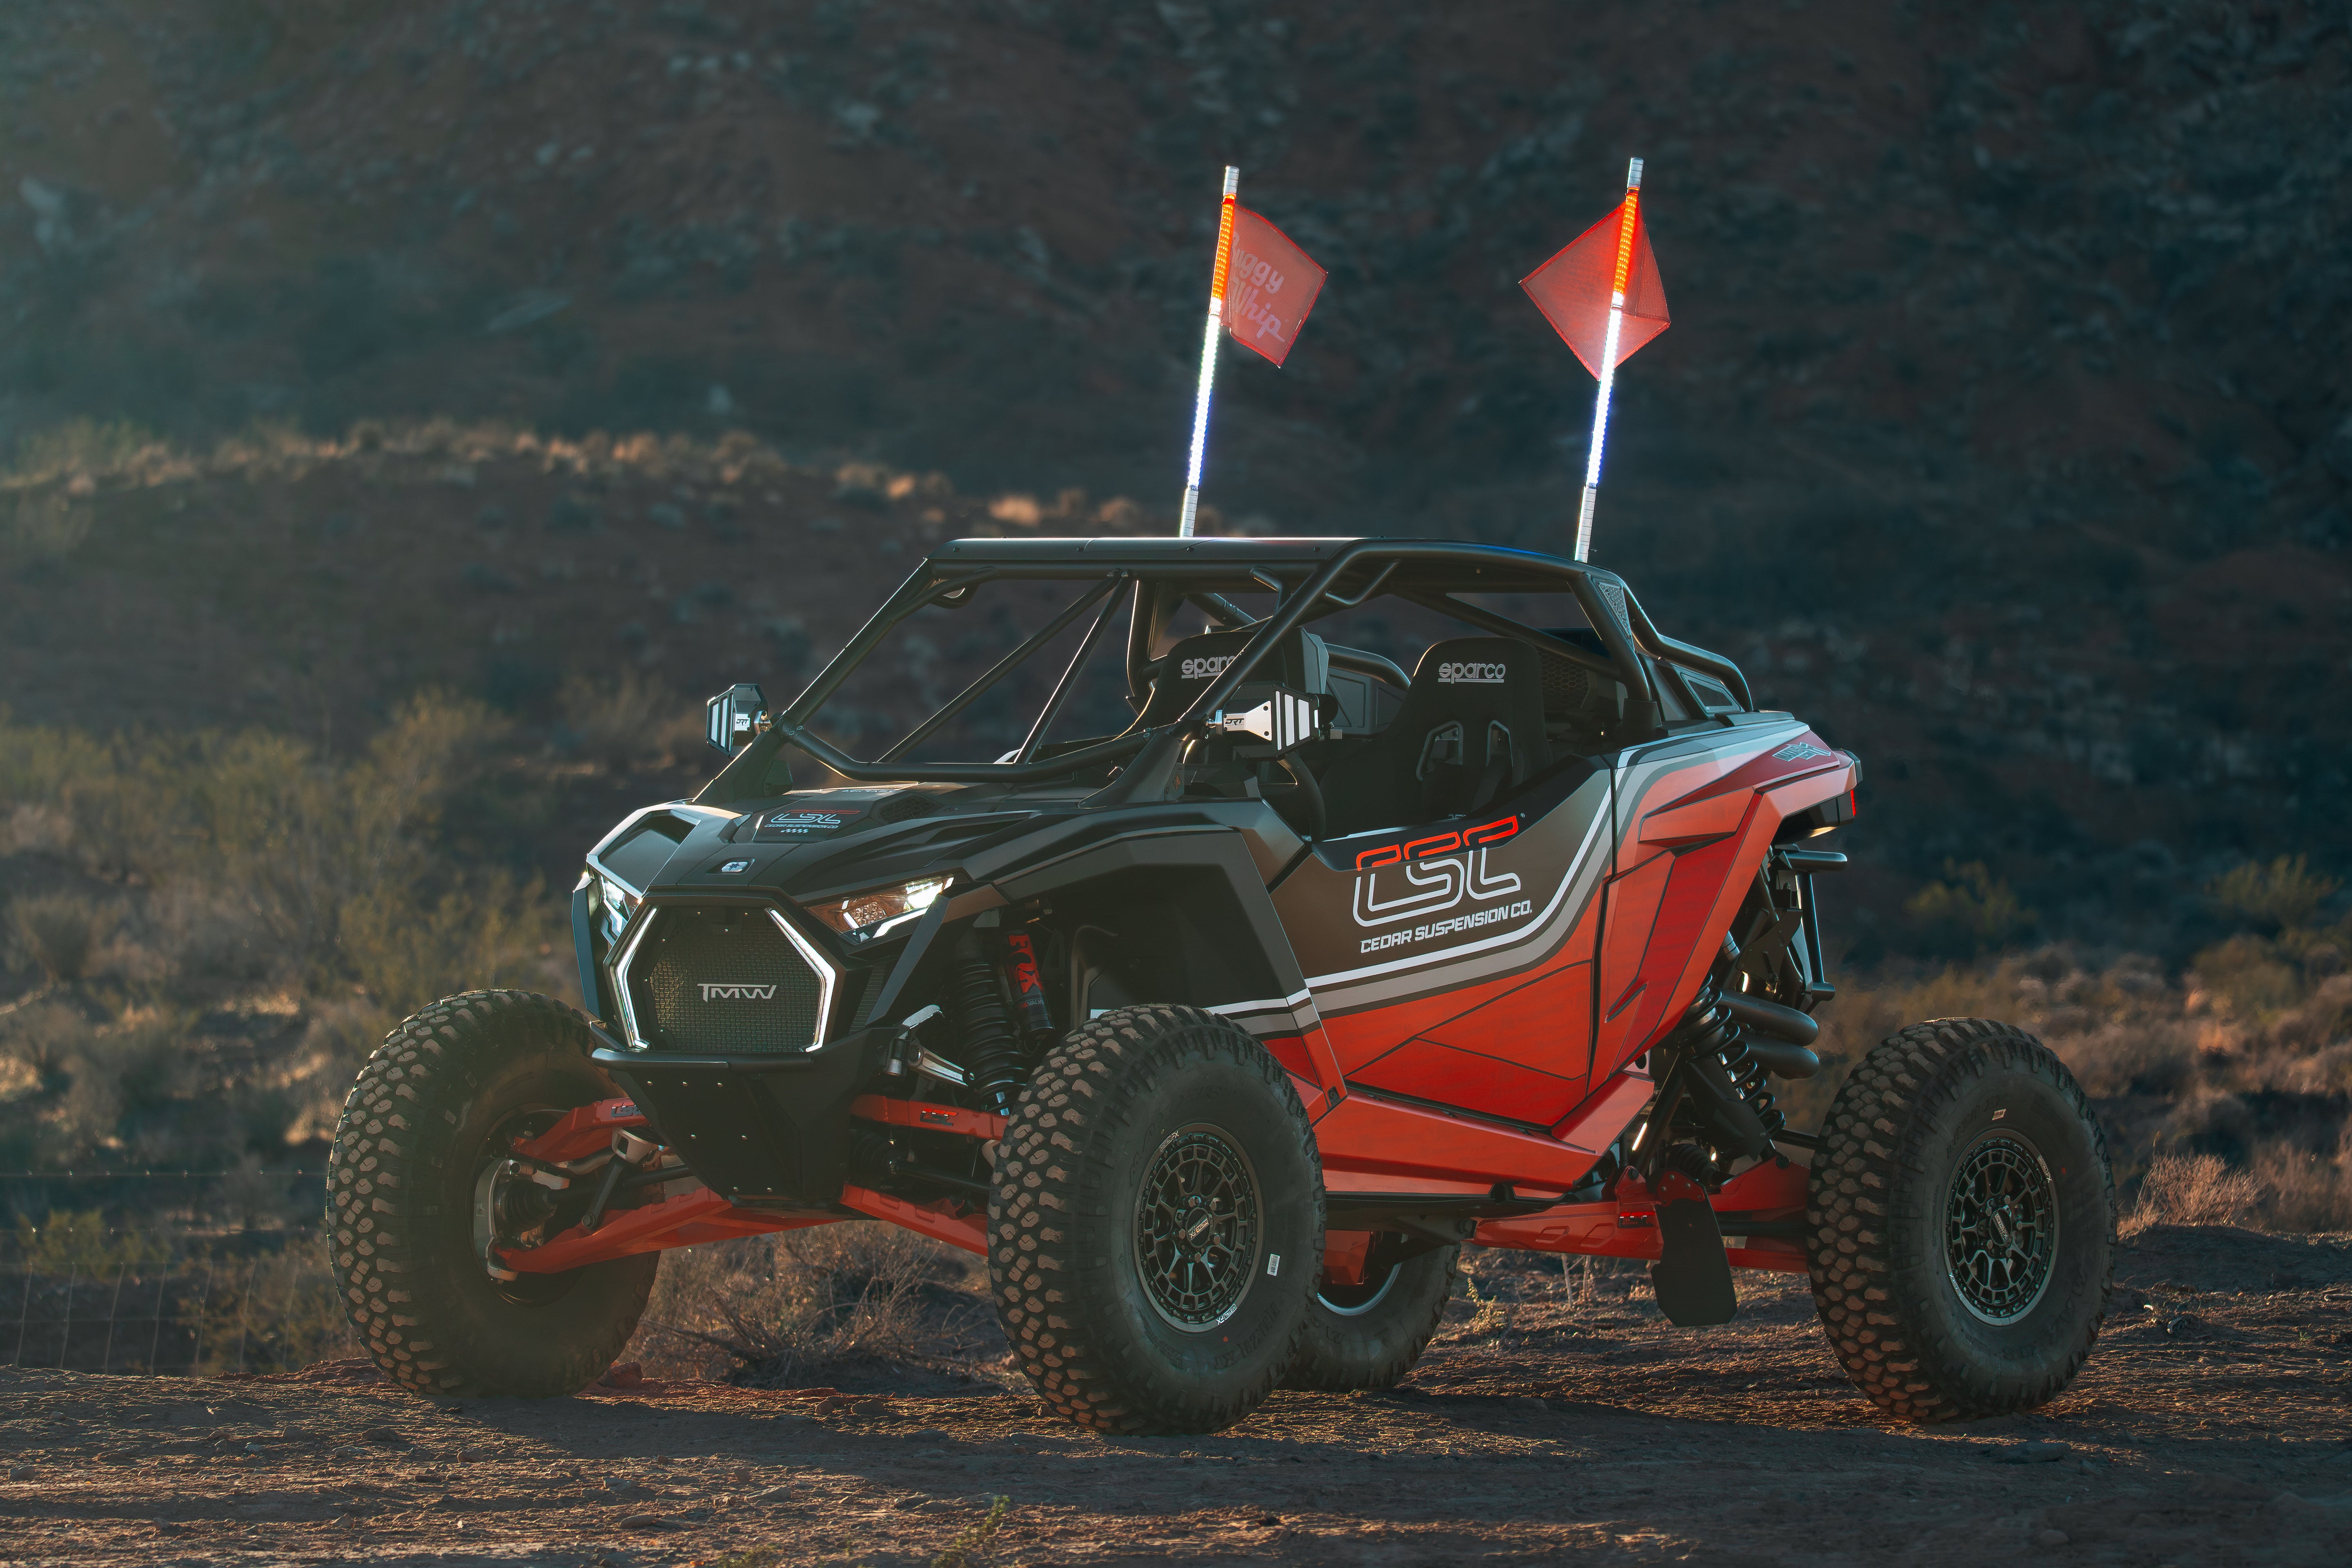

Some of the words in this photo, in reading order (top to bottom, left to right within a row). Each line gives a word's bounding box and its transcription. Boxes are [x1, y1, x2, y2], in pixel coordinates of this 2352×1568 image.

[1438, 662, 1506, 684] sparco
[1360, 929, 1411, 953] CEDAR
[1414, 905, 1509, 942] SUSPENSION
[1510, 900, 1532, 918] CO.
[697, 983, 777, 1003] TMW
[1171, 1130, 1179, 1140] FX
[1216, 1314, 1226, 1325] FX
[1224, 1305, 1236, 1319] METAL
